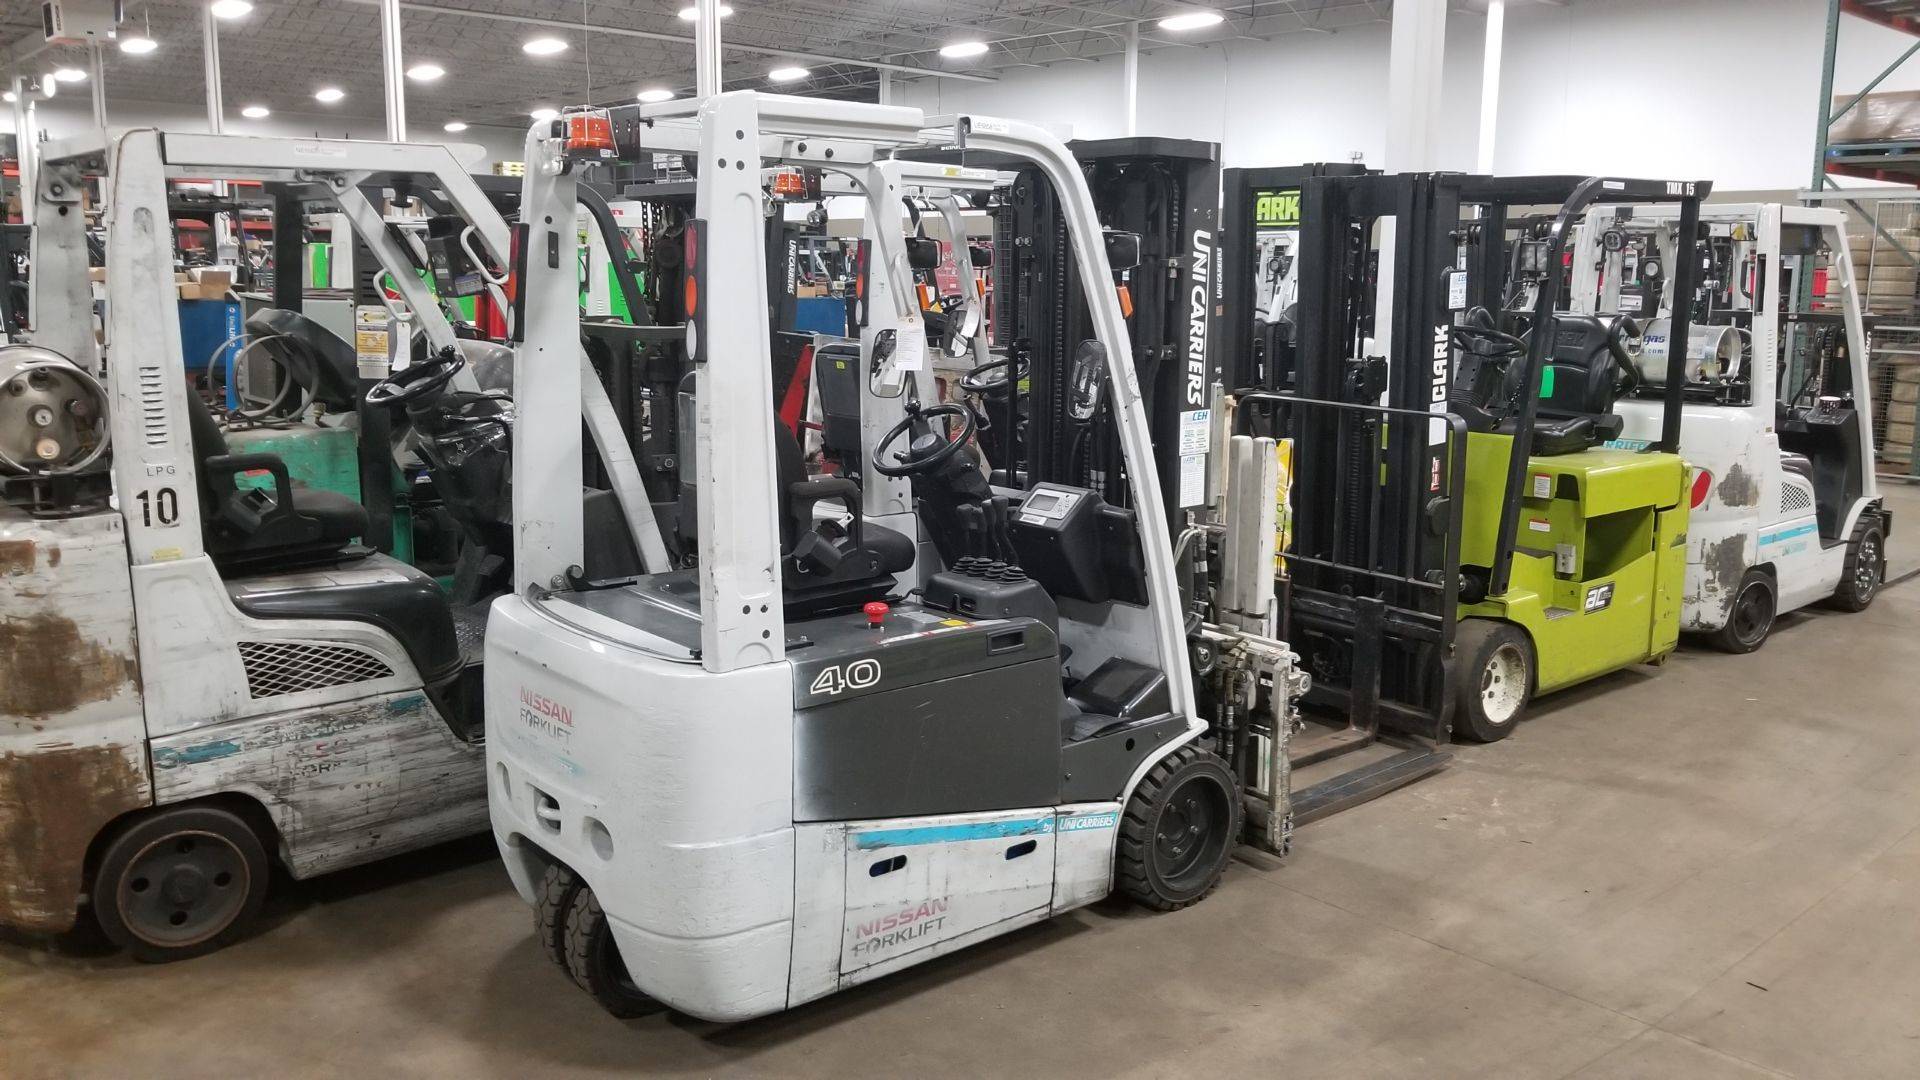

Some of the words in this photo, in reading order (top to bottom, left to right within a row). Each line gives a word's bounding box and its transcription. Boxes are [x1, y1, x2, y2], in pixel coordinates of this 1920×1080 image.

[1666, 181, 1683, 195] TMX
[1686, 182, 1695, 196] 15
[1187, 229, 1212, 406] UNICARRIERS
[1432, 324, 1449, 402] CLARK
[1192, 411, 1208, 421] CEH
[146, 465, 176, 477] LPG
[136, 487, 179, 527] 10
[810, 658, 881, 695] 40
[520, 686, 573, 728] NISSAN
[851, 916, 947, 957] FORKLIFT
[855, 897, 948, 939] NISSAN
